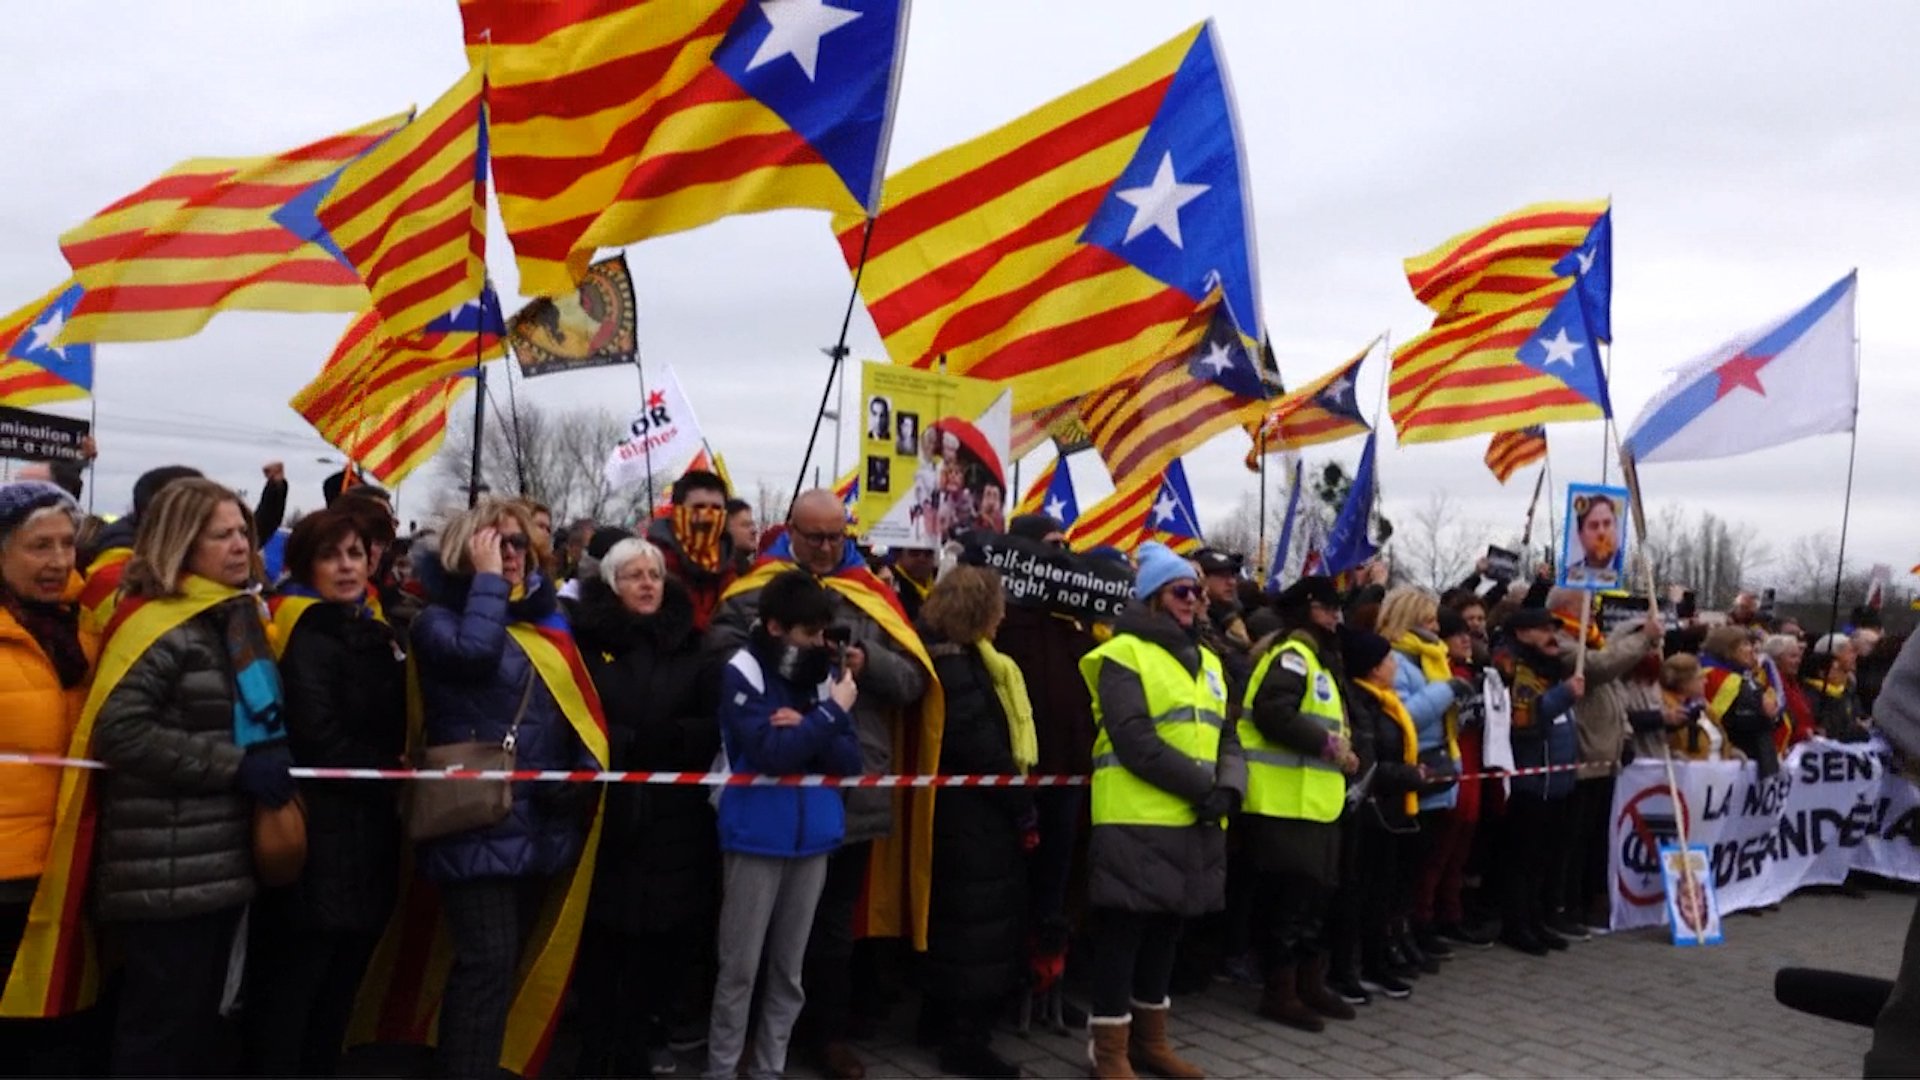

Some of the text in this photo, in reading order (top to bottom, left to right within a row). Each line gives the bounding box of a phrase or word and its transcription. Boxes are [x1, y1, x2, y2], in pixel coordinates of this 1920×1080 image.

[1057, 588, 1089, 608] not
[1094, 598, 1107, 612] a
[1702, 784, 1734, 821] LA
